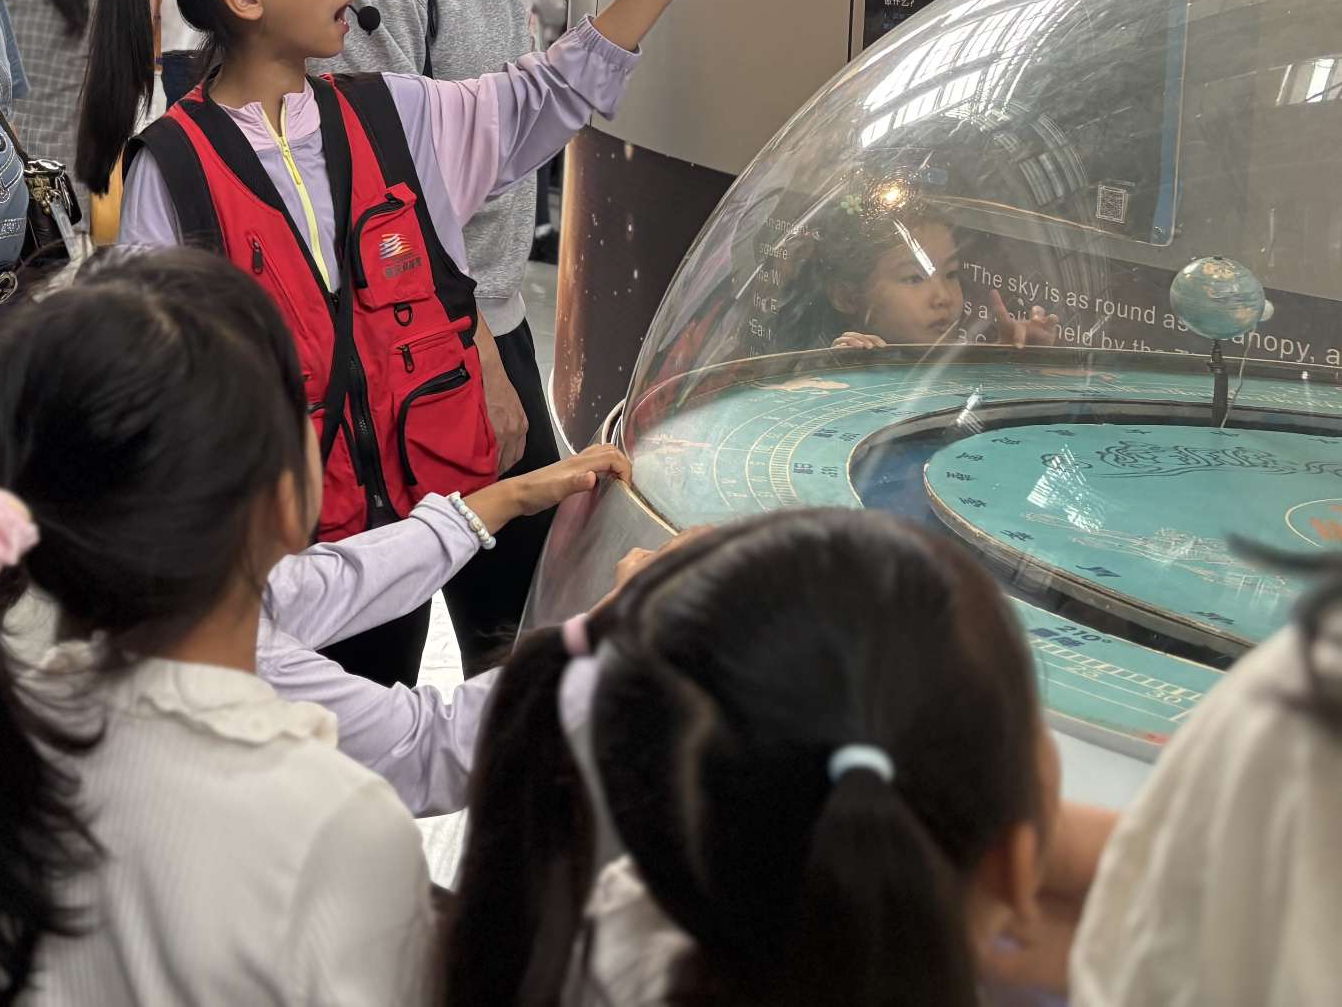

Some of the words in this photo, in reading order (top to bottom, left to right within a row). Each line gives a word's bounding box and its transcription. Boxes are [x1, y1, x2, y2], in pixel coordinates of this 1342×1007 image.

[1008, 275, 1039, 301] sky
[1045, 281, 1059, 303] is
[1066, 292, 1089, 309] as
[1095, 297, 1156, 324] round
[1231, 331, 1315, 364] anopy,
